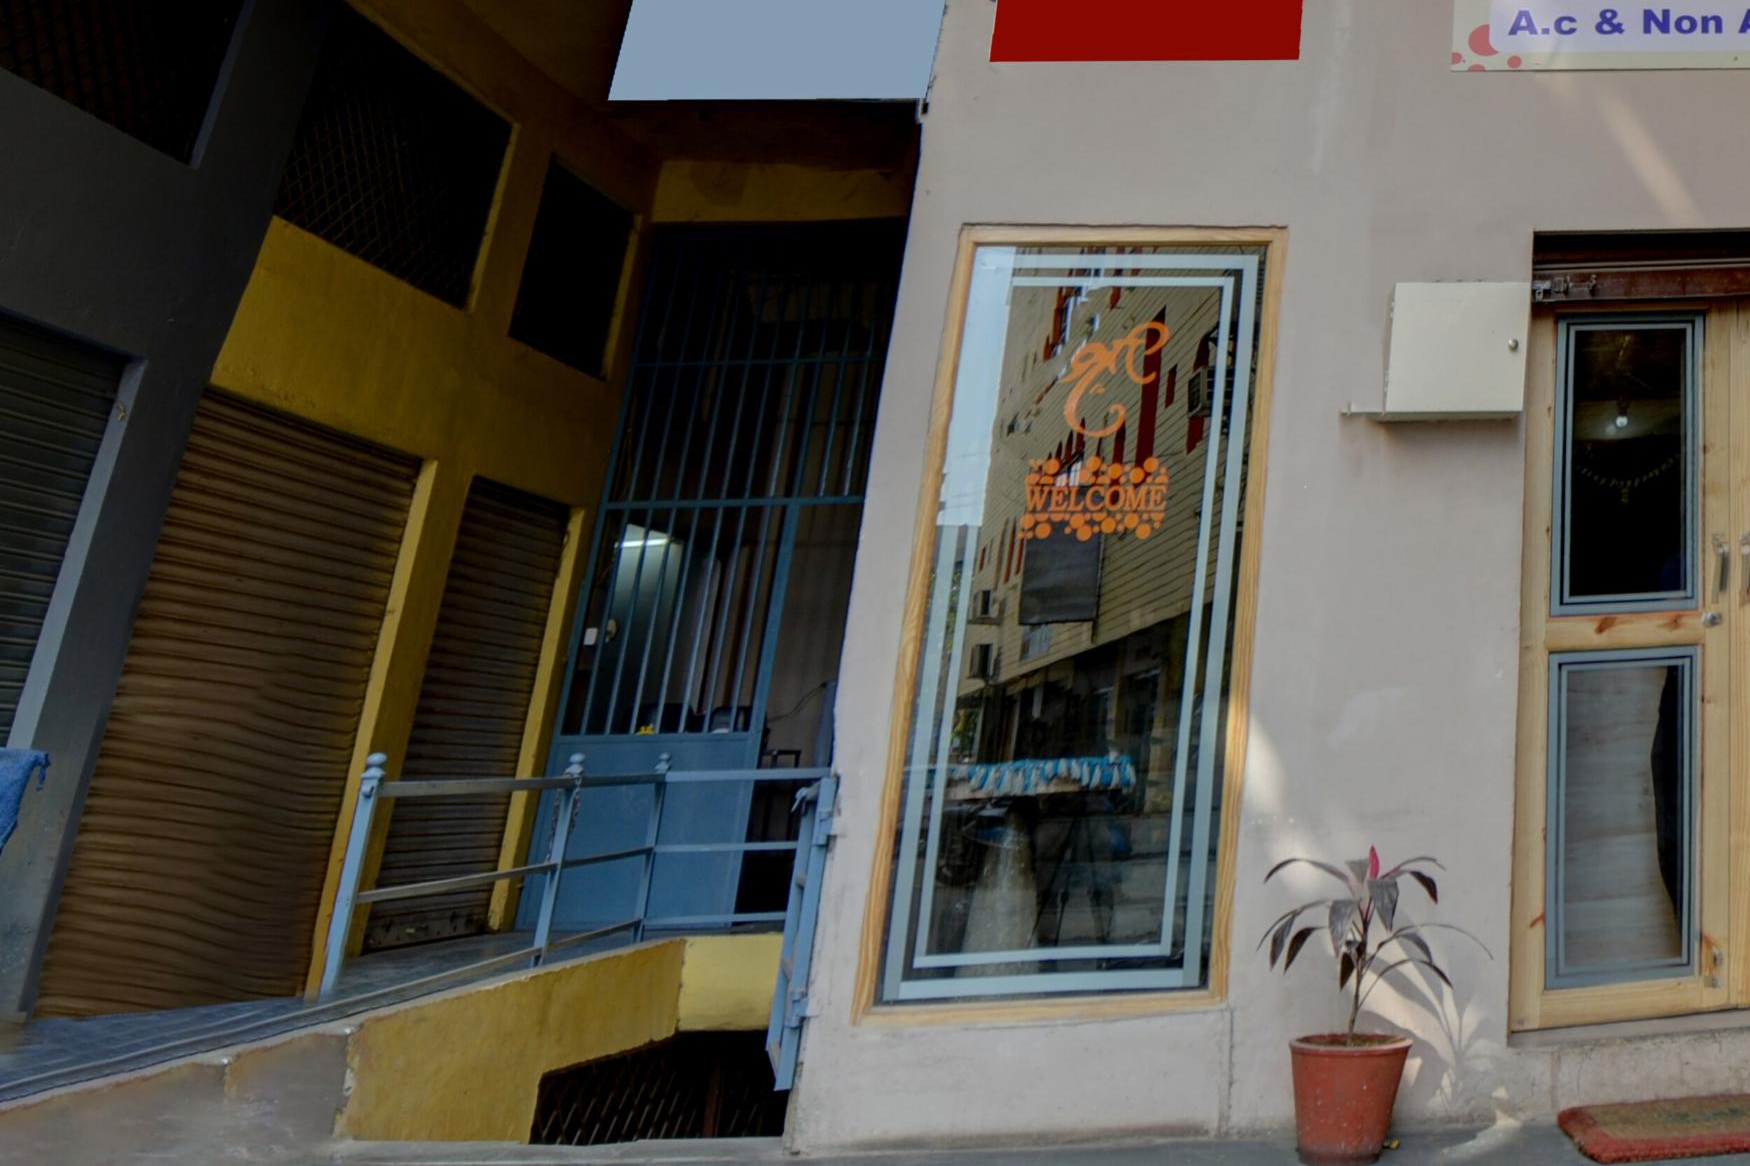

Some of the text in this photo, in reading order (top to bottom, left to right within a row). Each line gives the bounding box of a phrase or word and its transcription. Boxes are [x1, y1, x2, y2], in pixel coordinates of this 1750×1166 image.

[1508, 9, 1577, 35] A.c
[1594, 9, 1625, 35] &
[1643, 8, 1723, 34] Non
[1025, 484, 1169, 513] WELCOME
